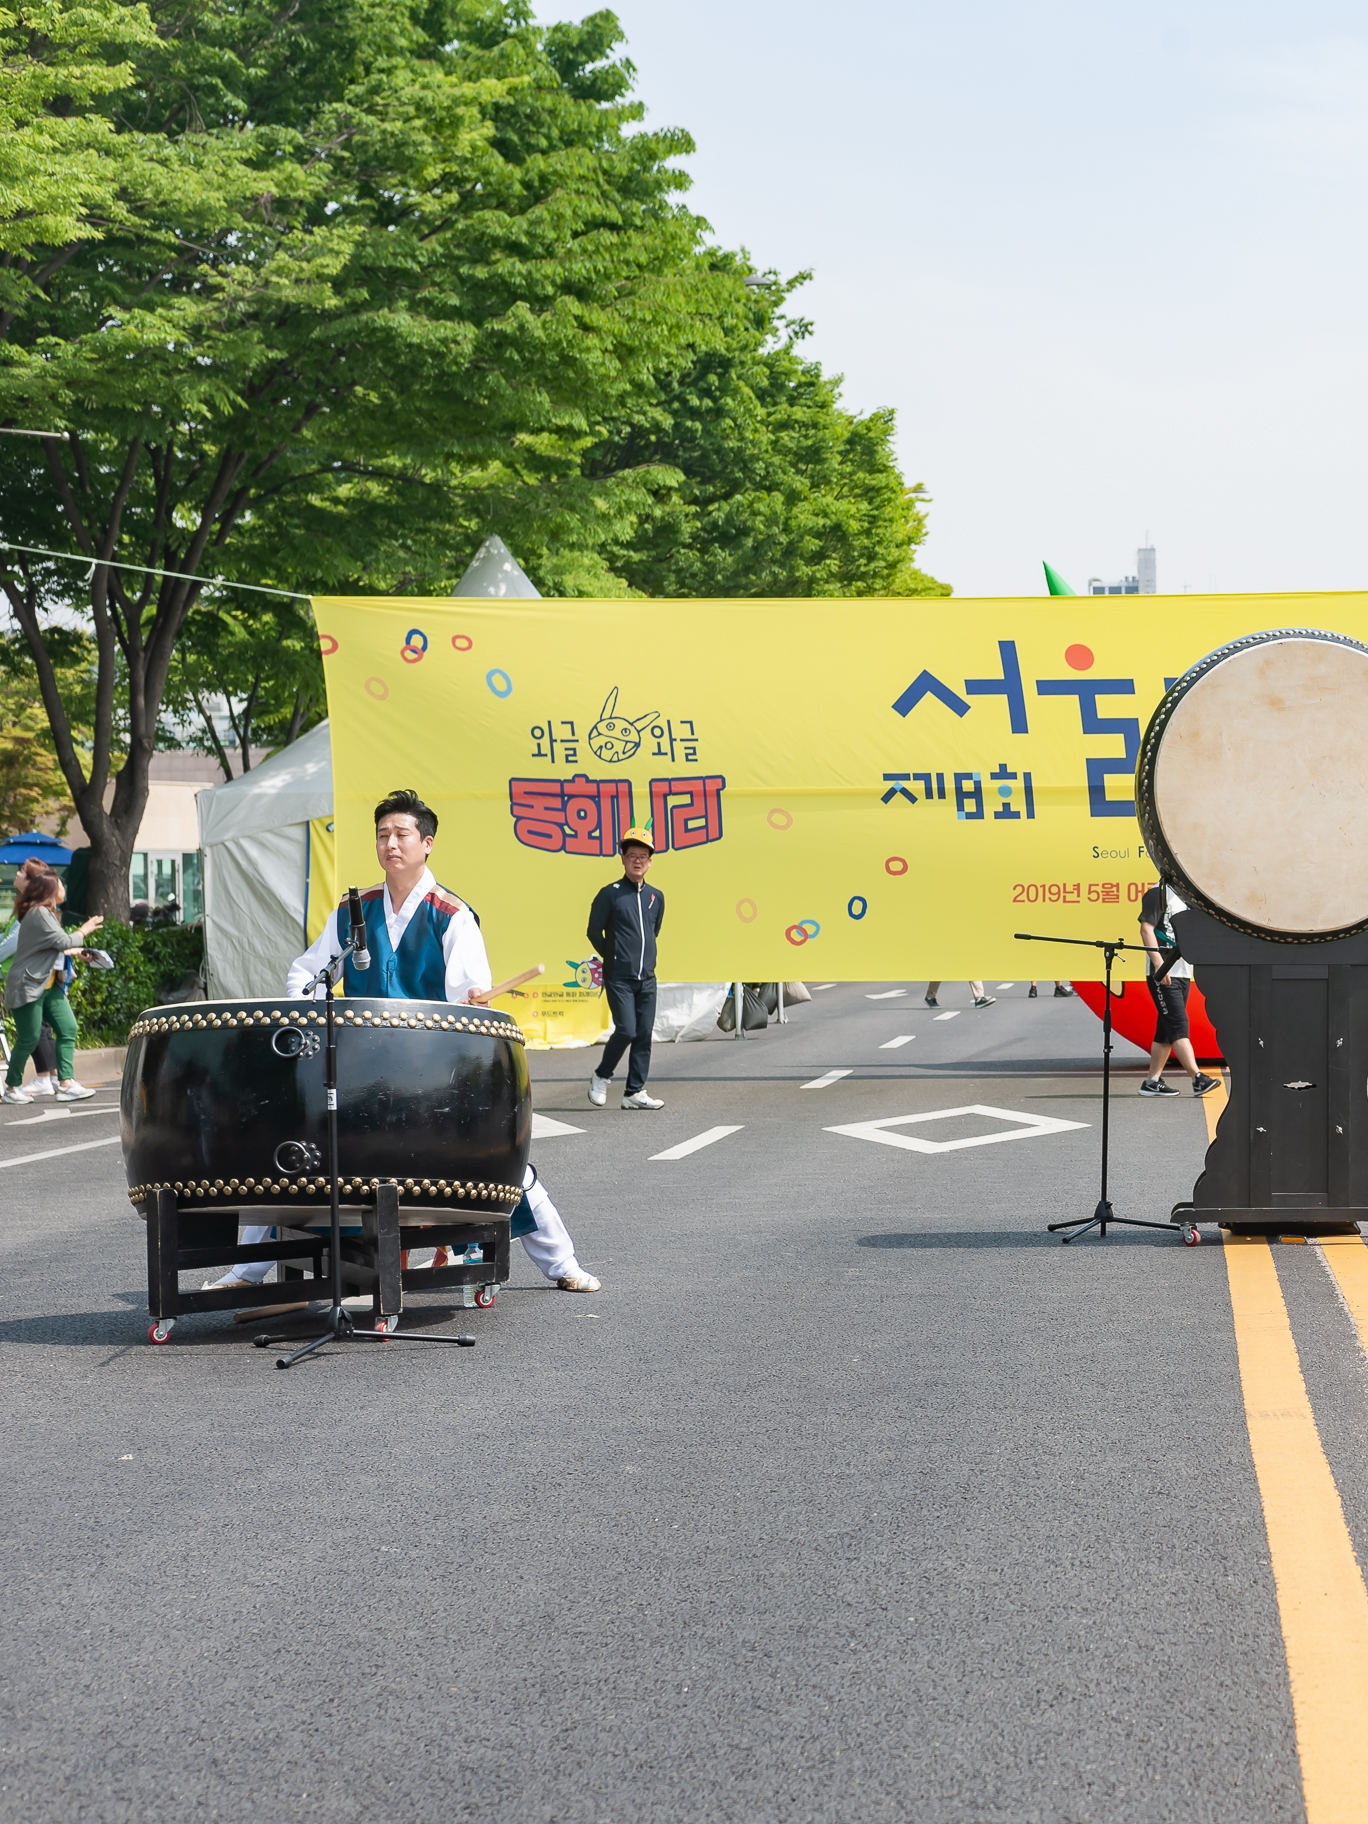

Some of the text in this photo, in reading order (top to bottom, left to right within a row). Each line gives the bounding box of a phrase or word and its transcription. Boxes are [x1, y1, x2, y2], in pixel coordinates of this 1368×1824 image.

[531, 719, 699, 763] 와글 와글
[1092, 846, 1130, 858] Seoul
[1012, 882, 1081, 904] 2019년
[1087, 882, 1120, 903] 5월
